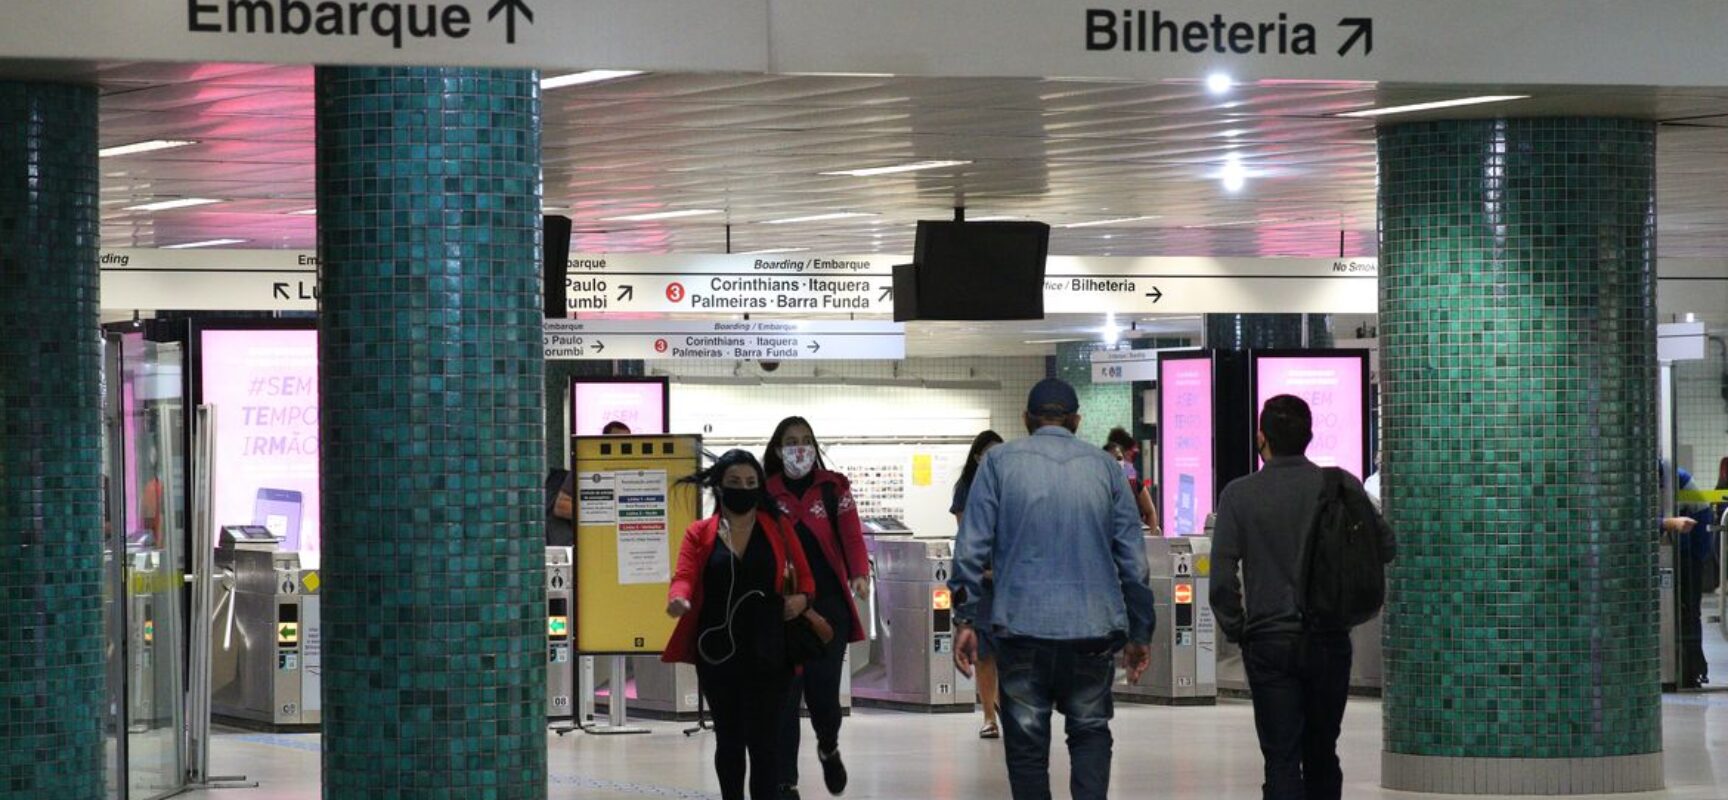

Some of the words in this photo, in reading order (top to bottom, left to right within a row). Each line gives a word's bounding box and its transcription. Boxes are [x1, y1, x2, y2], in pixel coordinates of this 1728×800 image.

[187, 0, 472, 49] Embarque
[1085, 9, 1317, 55] Bilheteria
[100, 253, 129, 266] ding
[754, 259, 804, 272] Boarding
[813, 259, 871, 272] Embarque
[1332, 262, 1347, 272] No
[710, 277, 800, 292] Corinthians
[808, 277, 870, 295] Itaquera
[1071, 278, 1136, 292] Bilheteria
[566, 295, 608, 309] umbi
[691, 294, 767, 309] Palmeiras
[777, 294, 818, 309] Barra
[823, 294, 870, 309] Funda
[714, 322, 751, 332] Boarding
[552, 335, 583, 345] Paulo
[686, 336, 745, 347] Corinthians
[756, 336, 798, 348] Itaquera
[672, 347, 723, 358] Palmeiras
[734, 347, 762, 358] Barra
[766, 347, 798, 358] Funda
